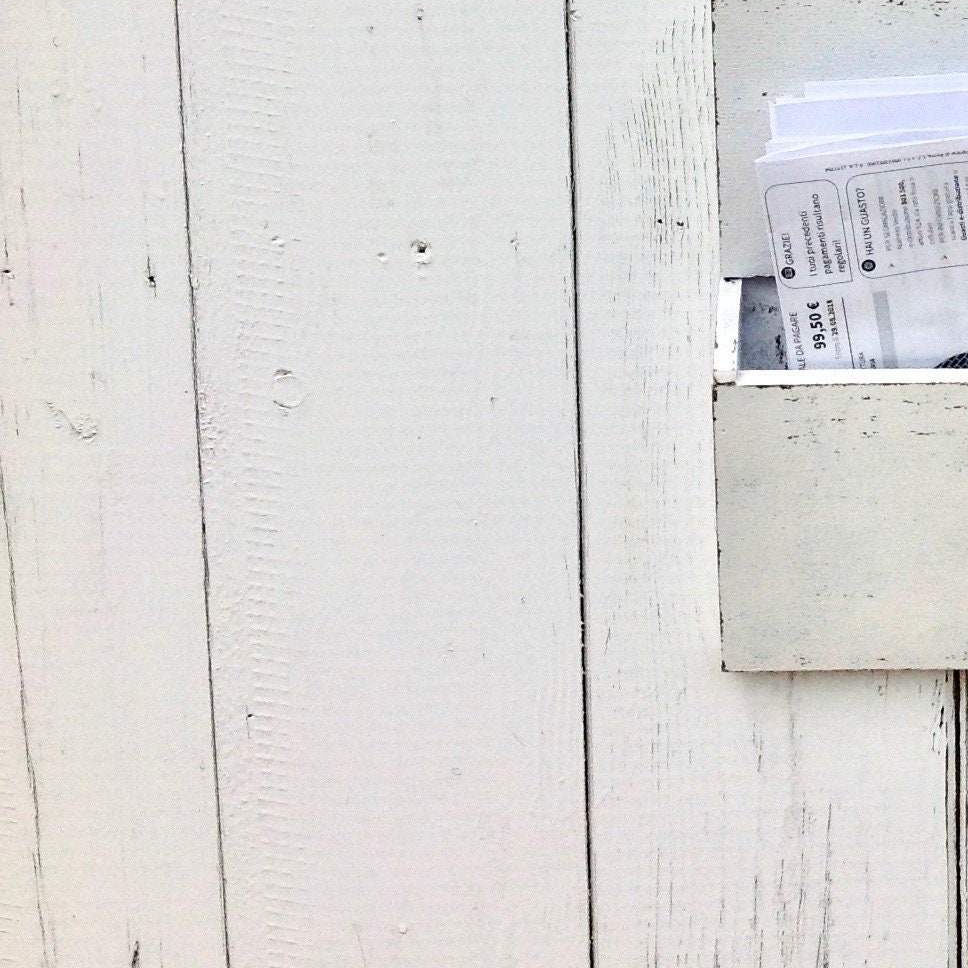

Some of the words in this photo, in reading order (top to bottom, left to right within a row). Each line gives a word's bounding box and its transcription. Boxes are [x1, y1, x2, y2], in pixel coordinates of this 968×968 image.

[810, 193, 824, 230] risultano
[855, 186, 869, 225] GUASTO?
[781, 232, 793, 265] GRAZIE!
[799, 210, 815, 255] precedenti
[862, 226, 872, 240] UN
[864, 241, 874, 256] HAI
[817, 231, 833, 274] pagamenti
[831, 239, 847, 273] regolari!
[806, 301, 819, 310] €
[788, 311, 801, 343] PAGARE
[808, 312, 827, 350] 99,50
[794, 344, 803, 355] DA
